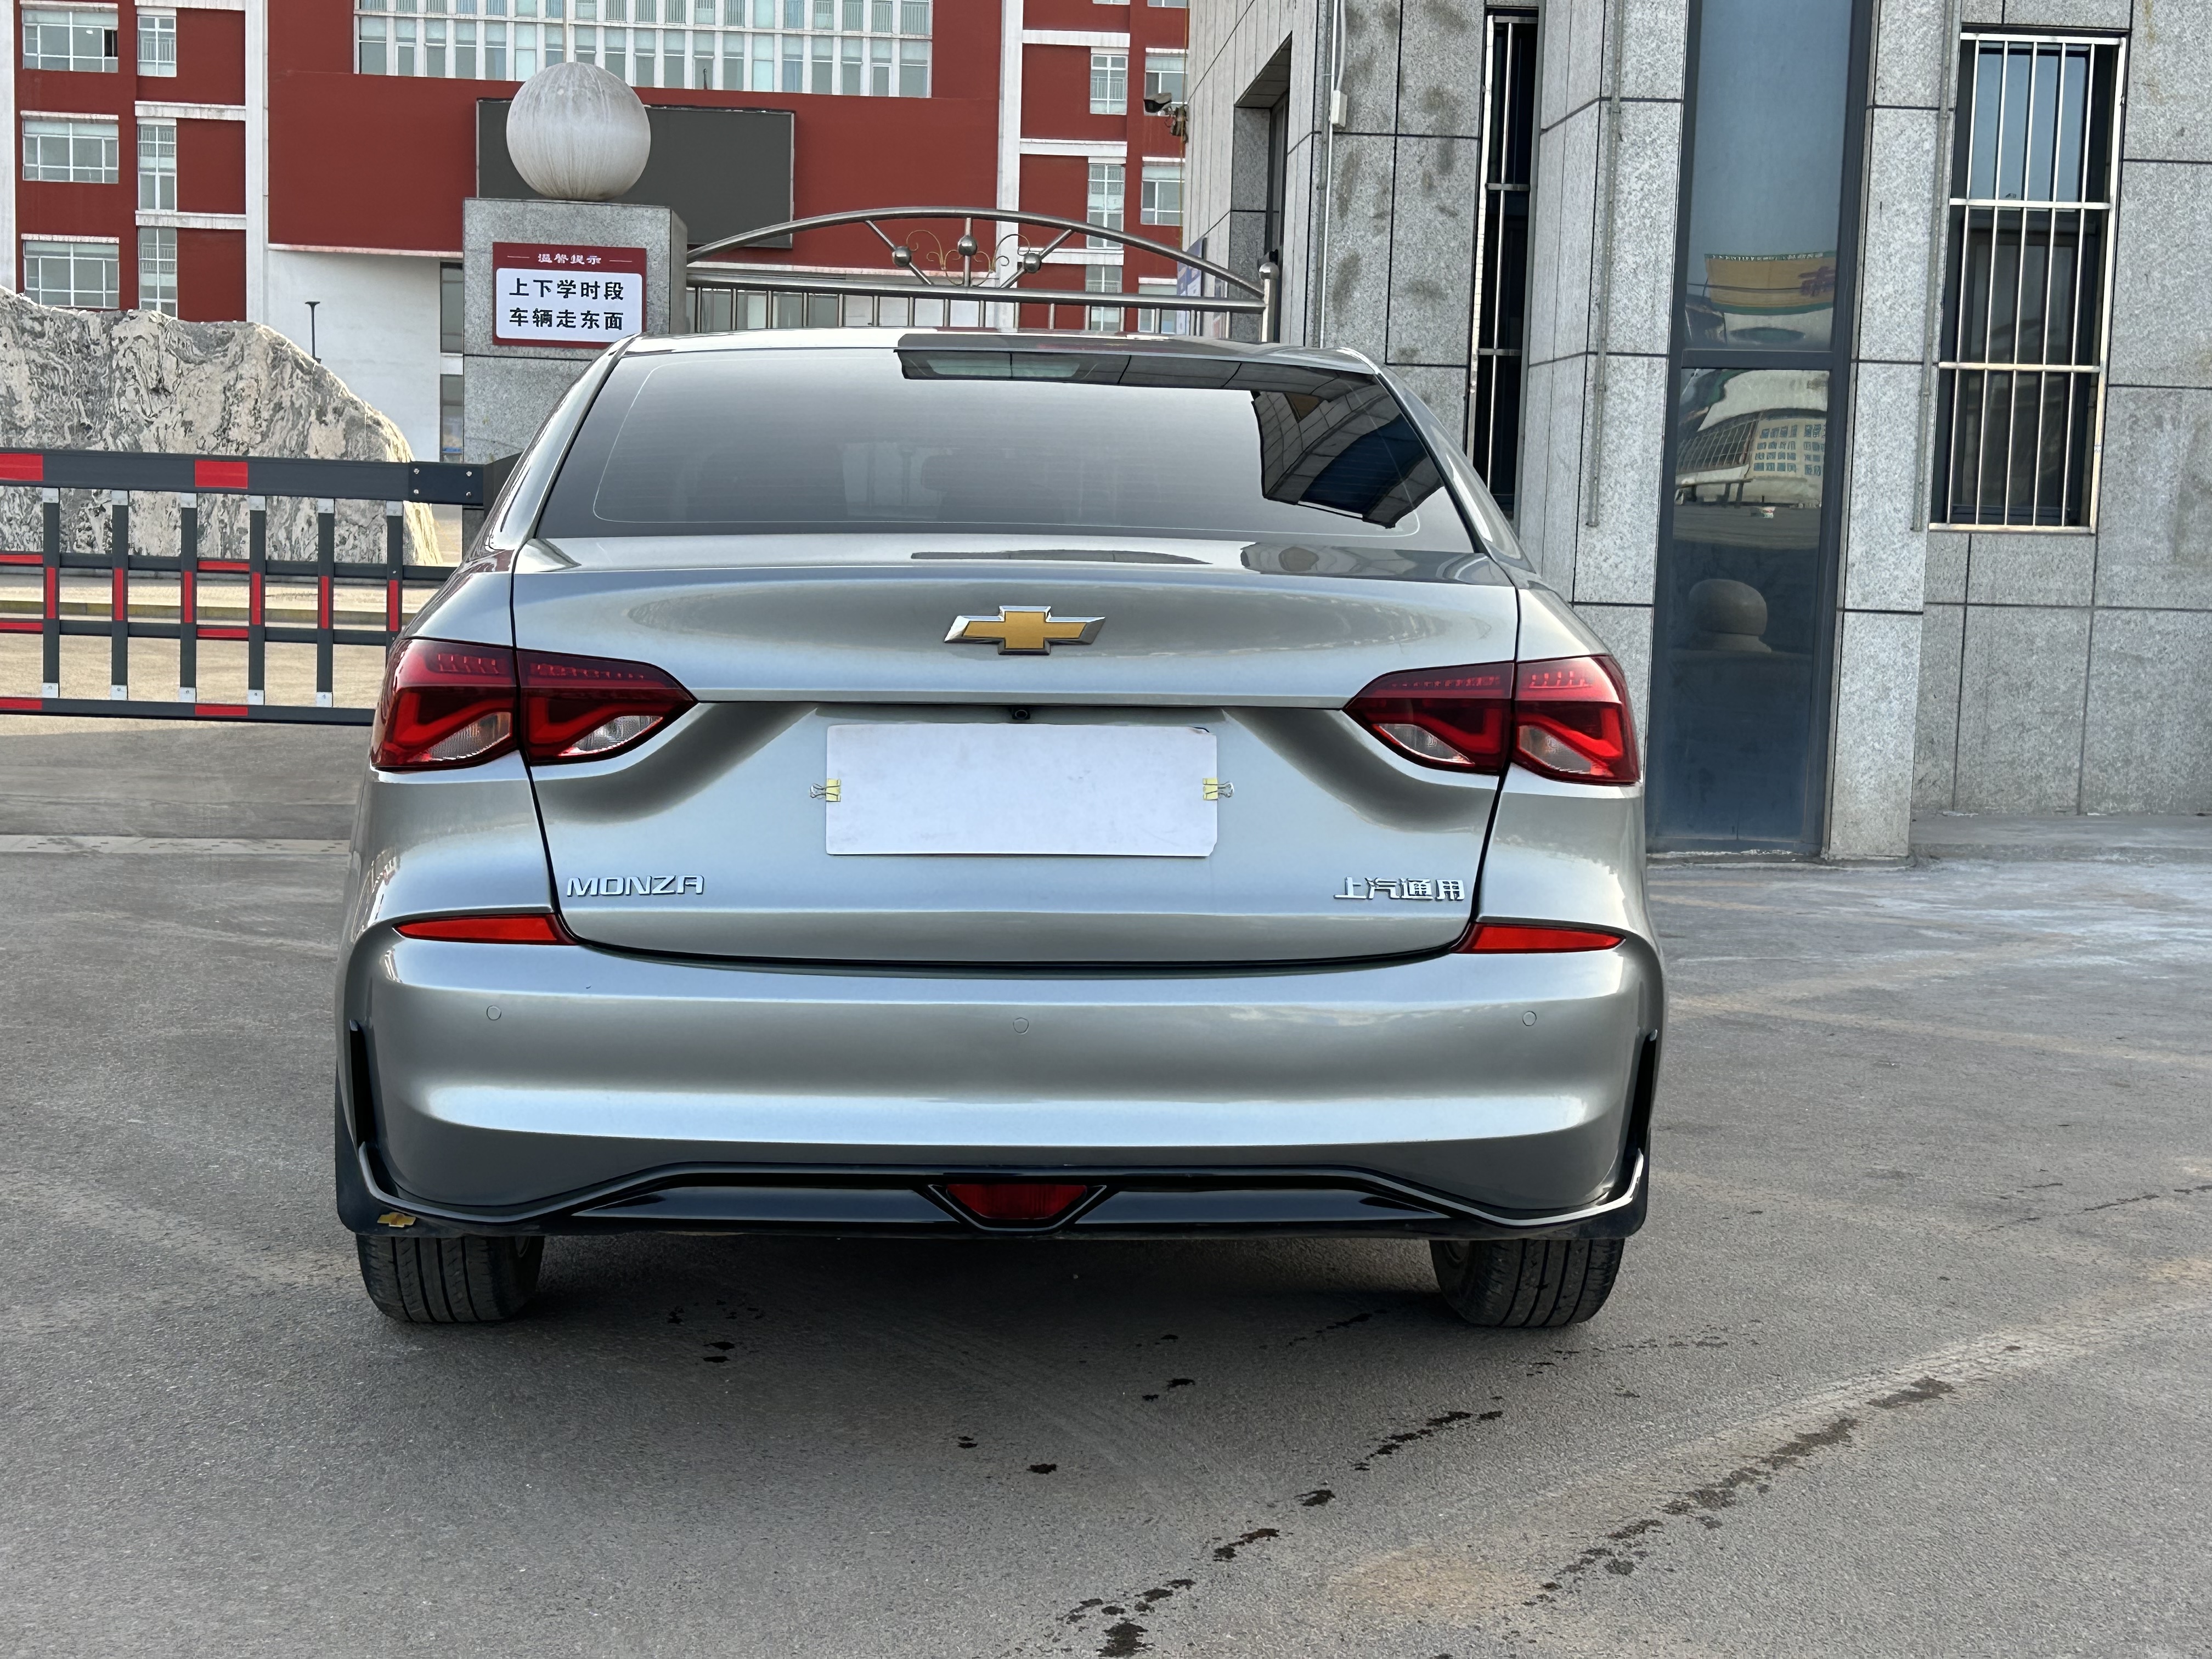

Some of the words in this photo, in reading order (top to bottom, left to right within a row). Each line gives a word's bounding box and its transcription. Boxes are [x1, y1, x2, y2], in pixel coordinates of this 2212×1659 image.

[509, 278, 624, 300] 上下学时段
[509, 308, 624, 330] 车辆走东面
[567, 875, 704, 897] MONZA
[1333, 877, 1465, 900] 上汽通用
